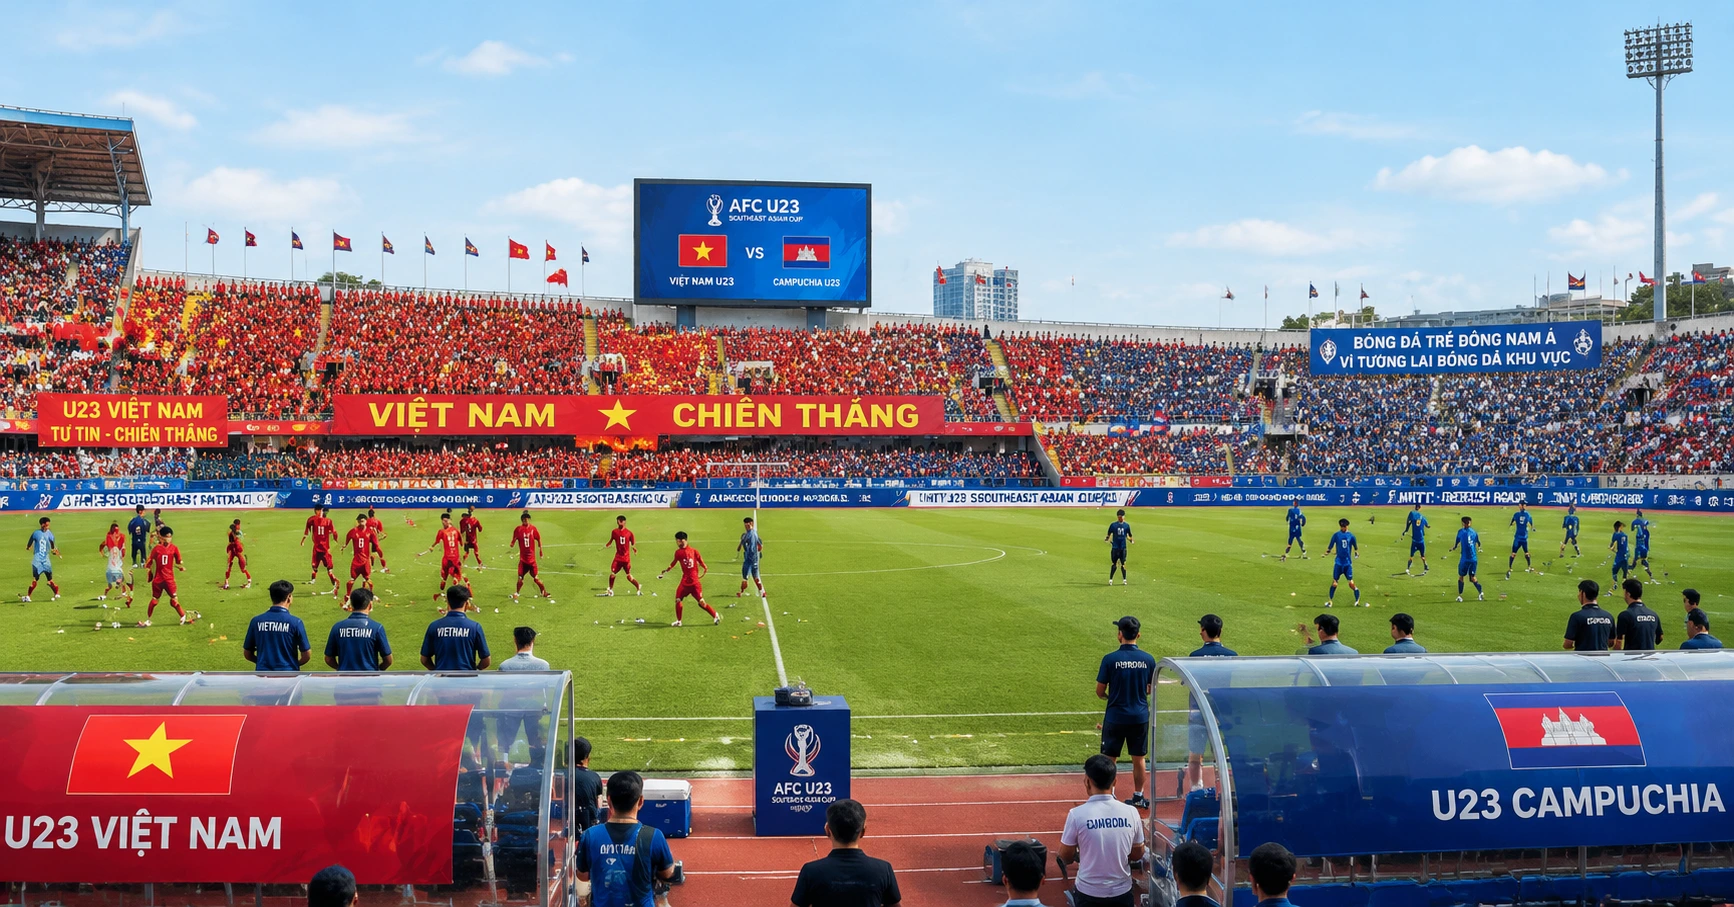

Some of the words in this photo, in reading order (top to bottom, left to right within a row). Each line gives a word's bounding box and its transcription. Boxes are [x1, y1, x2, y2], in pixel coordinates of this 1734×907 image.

[729, 199, 763, 213] AFC
[767, 199, 800, 214] U23
[745, 247, 764, 259] VS
[691, 277, 713, 286] NAM
[715, 277, 735, 286] U23
[773, 278, 823, 287] CAMPUCHIA
[1353, 333, 1396, 349] BÓNG
[1400, 331, 1421, 349] ĐÁ
[1458, 329, 1501, 347] ĐÔNG
[1506, 331, 1541, 346] NAM
[1545, 327, 1557, 345] Á
[1411, 354, 1433, 368] LAI
[1437, 350, 1478, 367] BÓNG
[1506, 352, 1536, 365] KHU
[1540, 350, 1571, 367] VỰC
[63, 401, 101, 419] U23
[107, 396, 151, 423] VIỆT
[157, 402, 203, 419] NAM
[368, 396, 454, 433] VIỆT
[468, 403, 555, 427] NAM
[75, 426, 100, 442] TIN
[774, 782, 802, 795] AFC
[805, 781, 832, 795] U23
[1431, 788, 1501, 821] U23
[1512, 783, 1726, 818] CAMPUCHIA
[5, 815, 79, 849] U23
[91, 808, 178, 857] VIỆT
[189, 816, 281, 849] NAM
